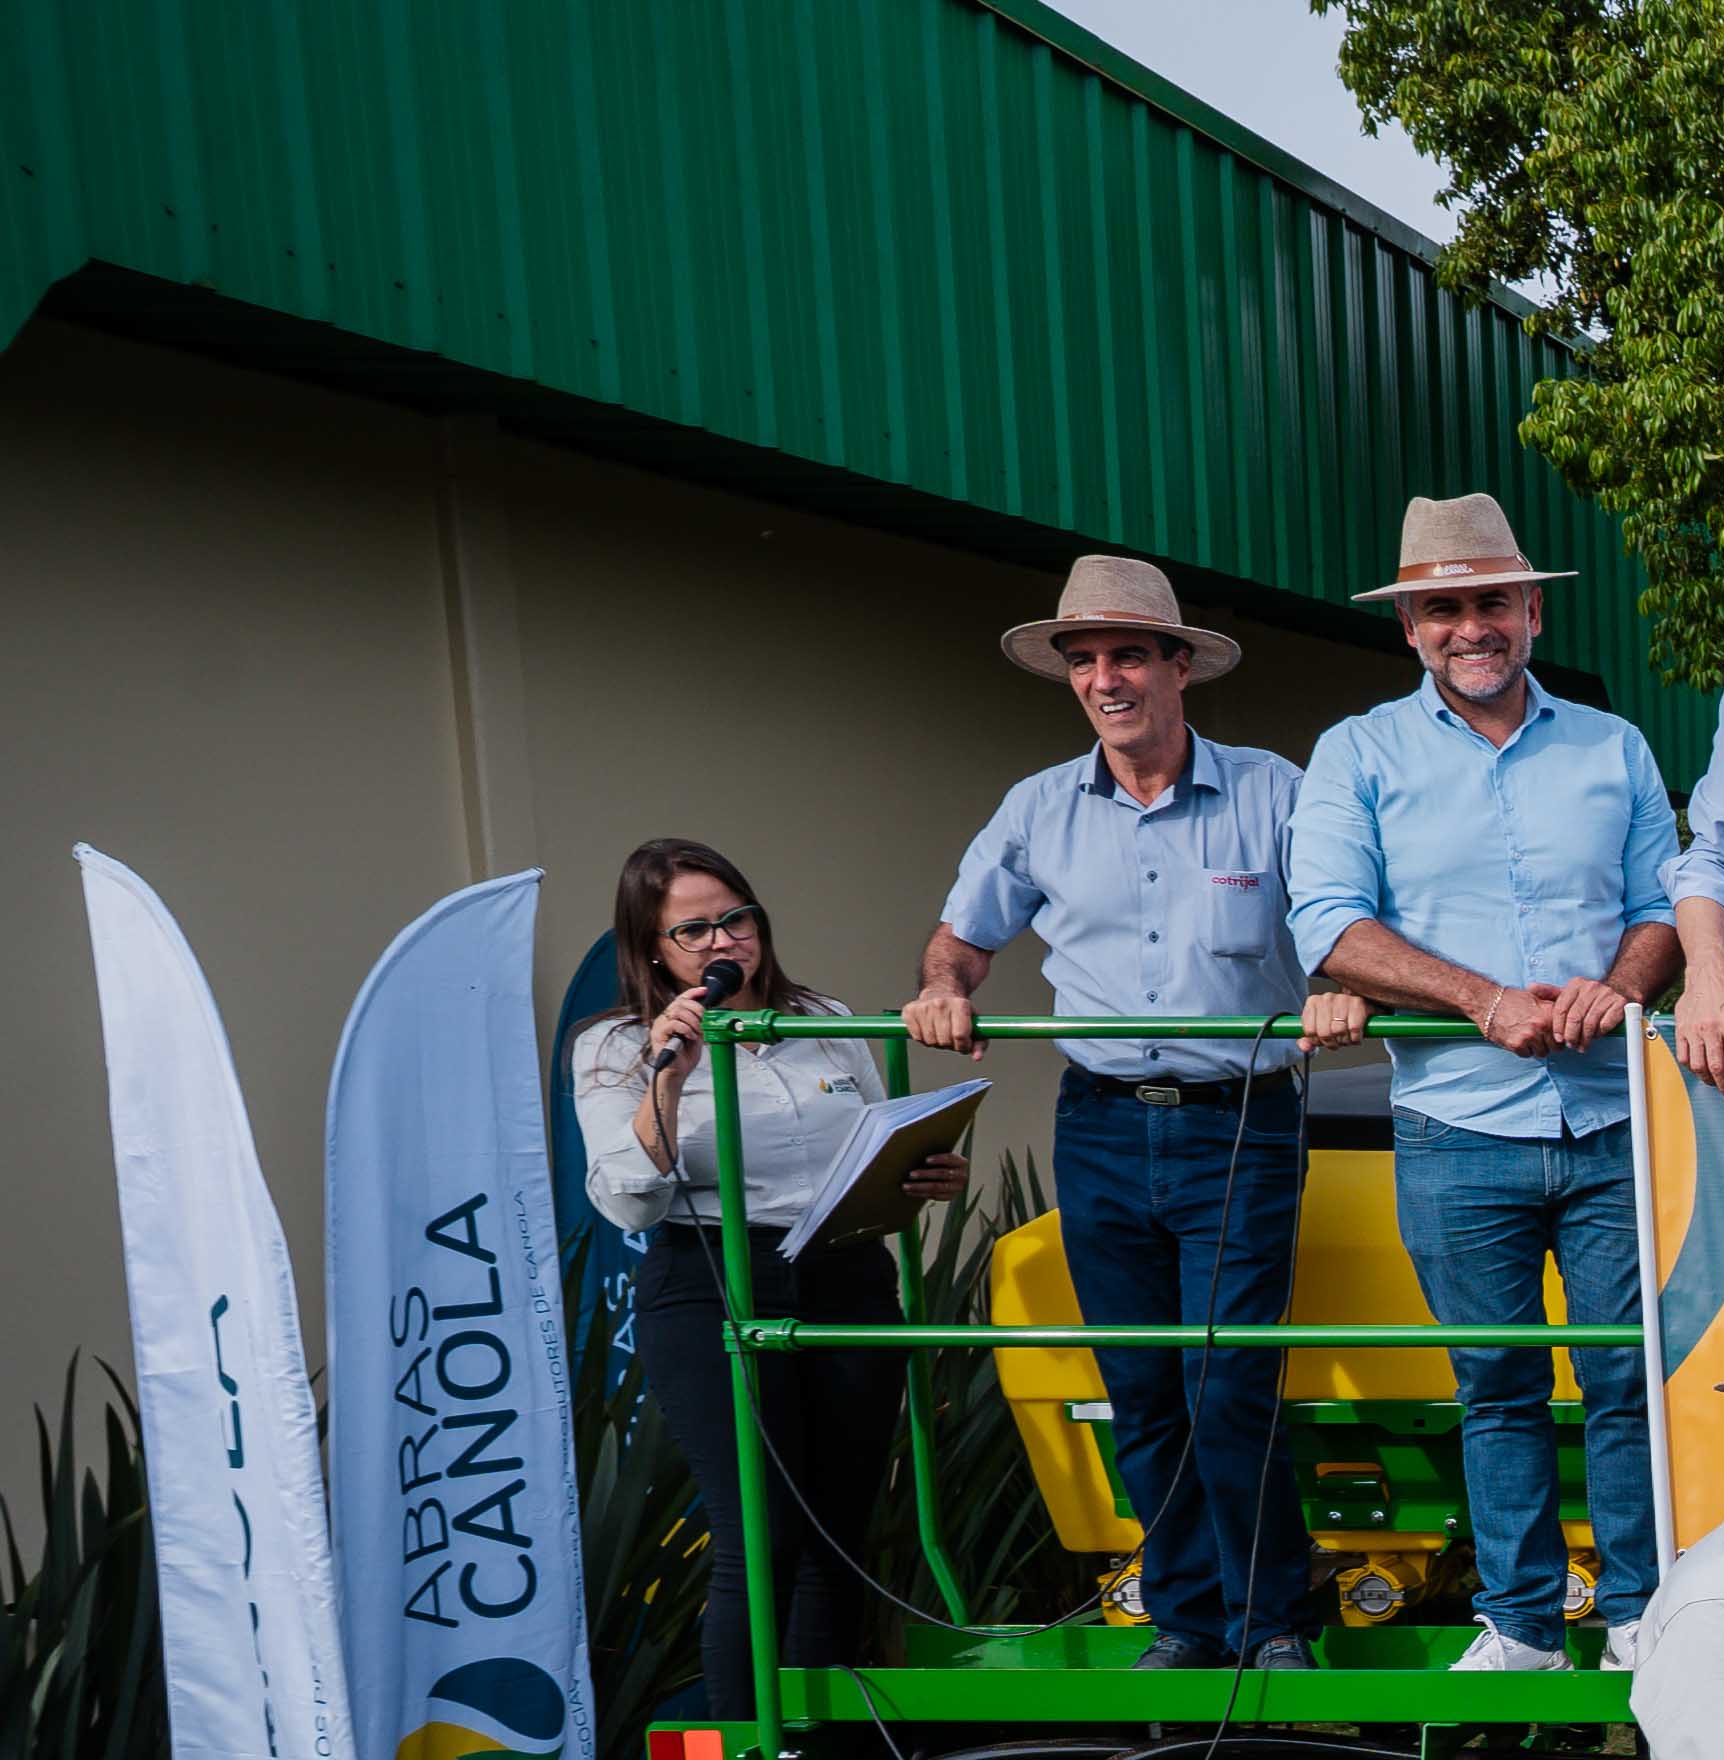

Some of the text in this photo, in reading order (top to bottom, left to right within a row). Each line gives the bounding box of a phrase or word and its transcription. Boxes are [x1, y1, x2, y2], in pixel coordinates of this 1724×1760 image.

[513, 1190, 538, 1280] CANOLA
[530, 1286, 553, 1314] DE
[390, 1285, 459, 1629] ABRAS
[425, 1192, 538, 1620] CANOLA
